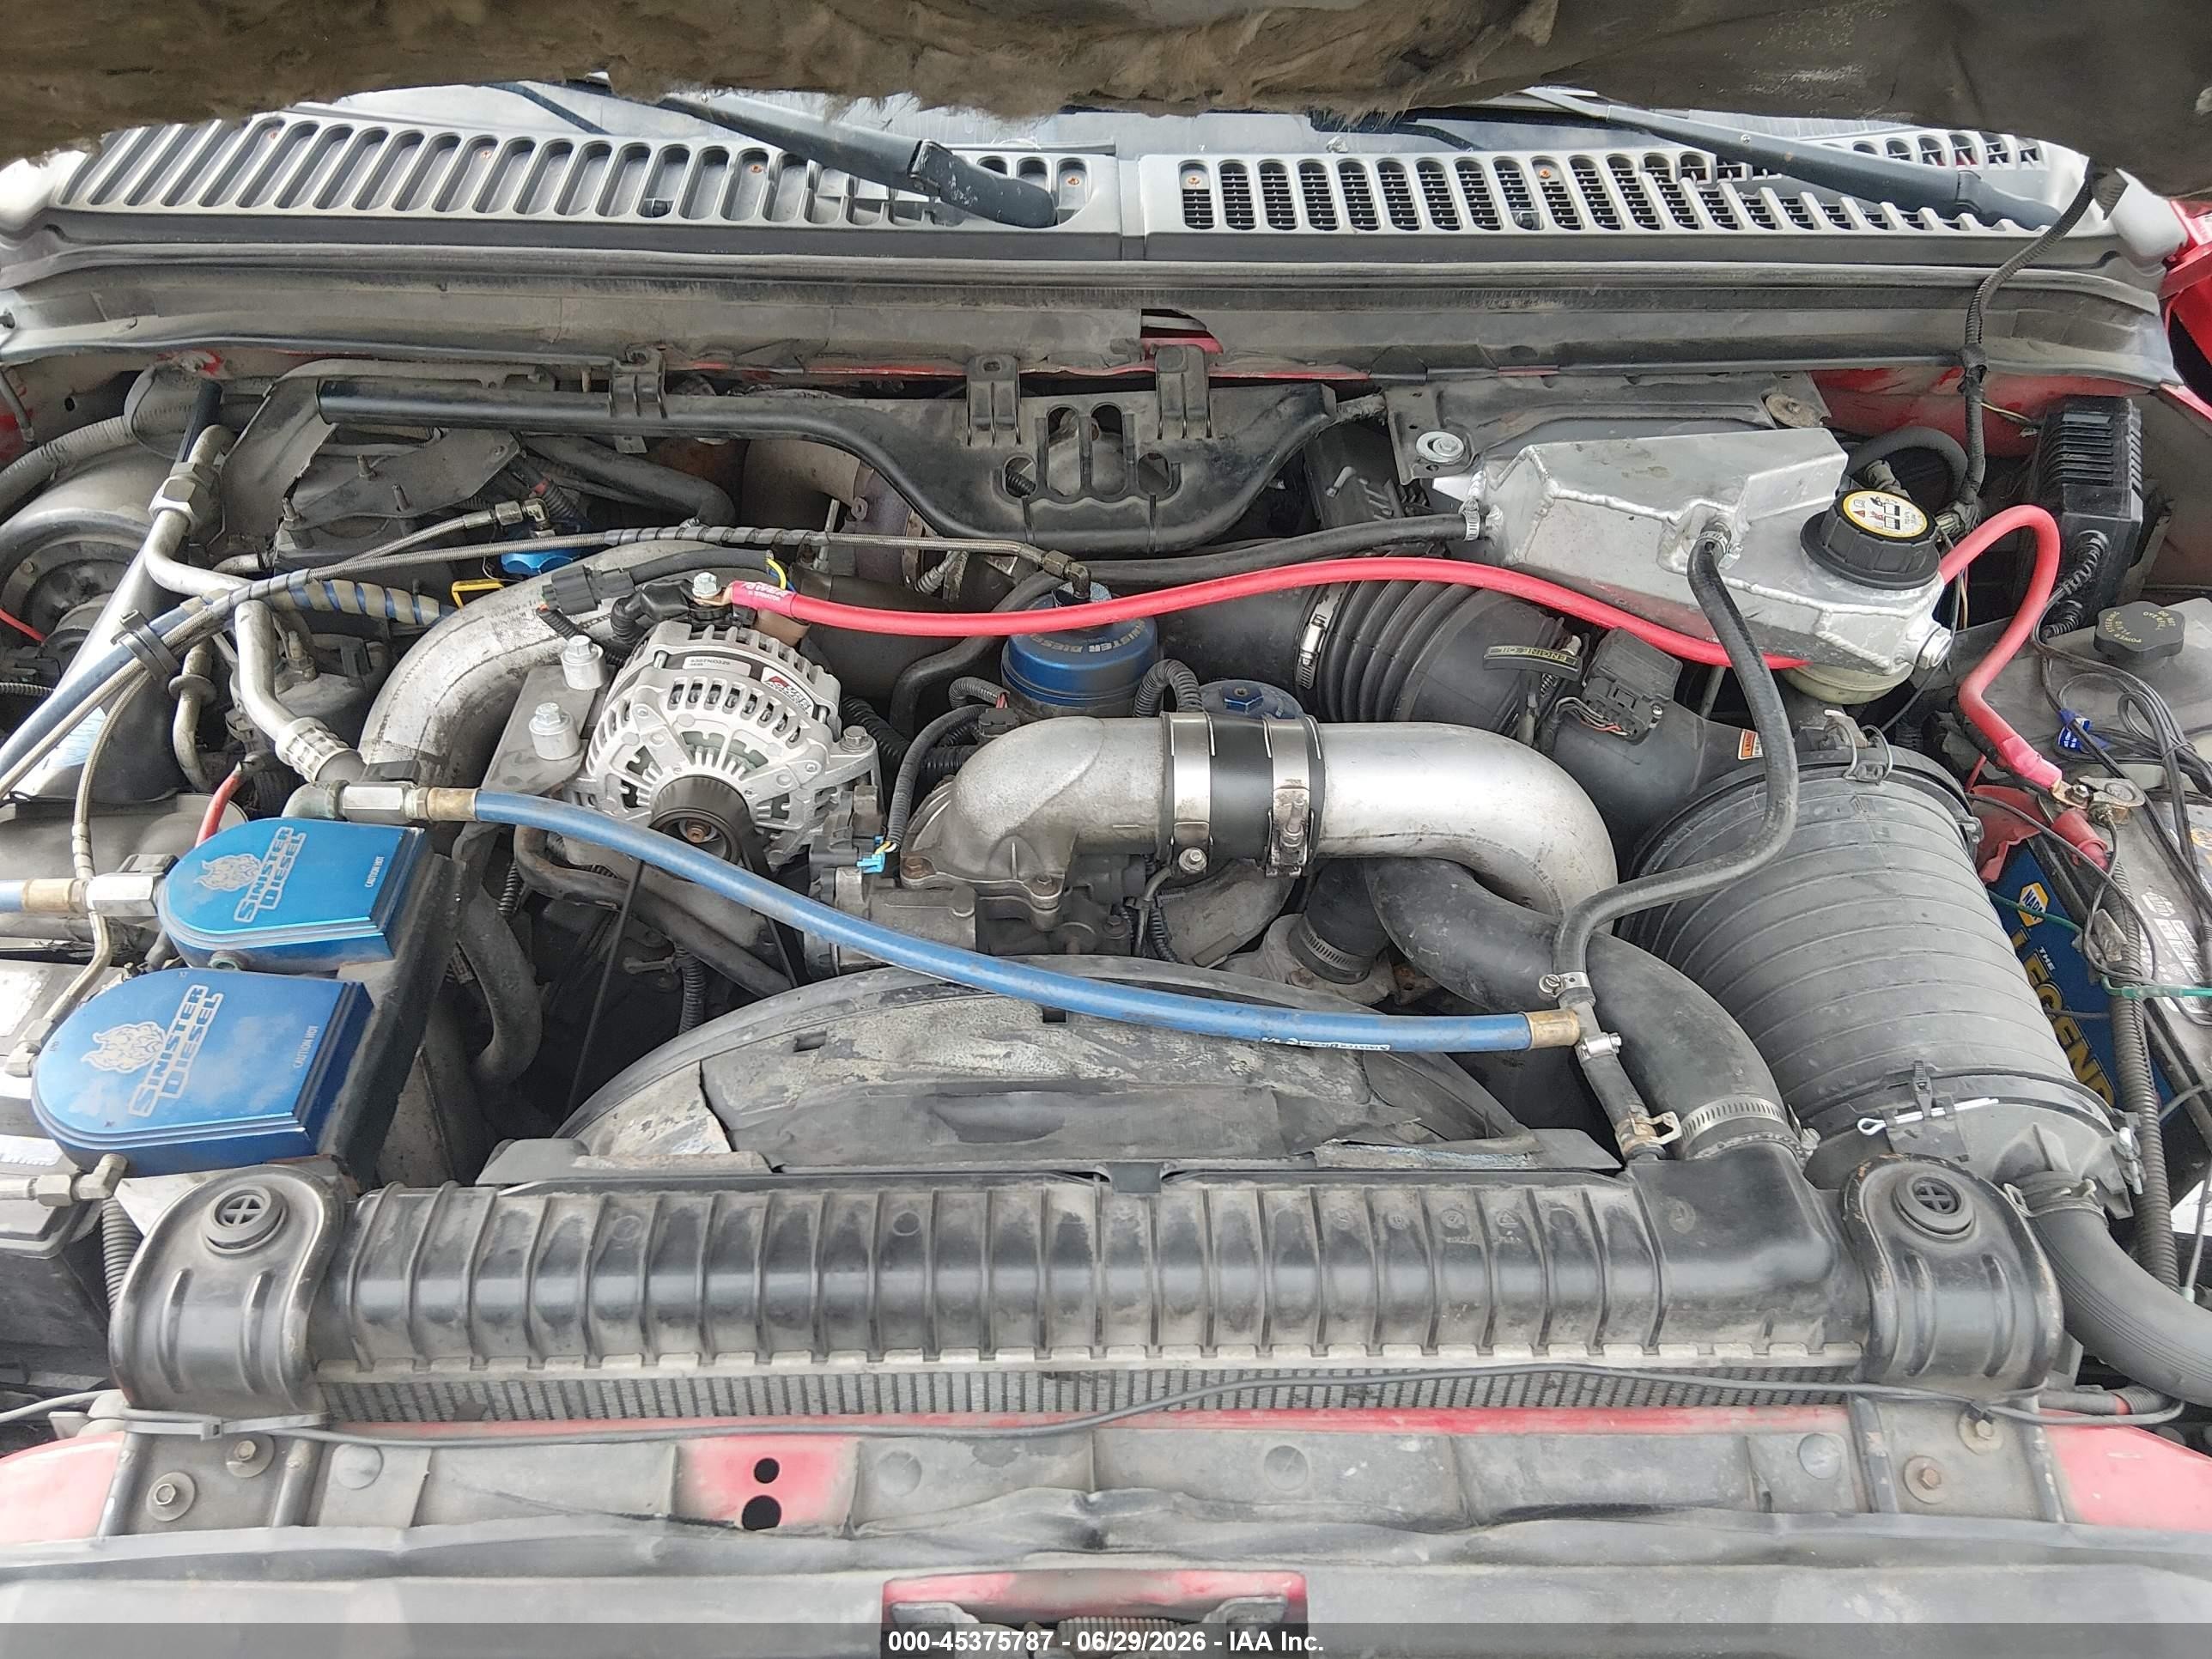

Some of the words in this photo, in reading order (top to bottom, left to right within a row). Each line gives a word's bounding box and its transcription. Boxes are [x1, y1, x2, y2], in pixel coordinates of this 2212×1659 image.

[1522, 648, 1567, 661] ENGINE
[2113, 634, 2142, 643] POWER
[234, 827, 293, 921] SINISTER
[260, 834, 305, 908] DIESEL
[2039, 946, 2056, 972] THE
[130, 986, 207, 1116] SINISTER
[159, 994, 223, 1097] DIESEL
[293, 1039, 314, 1068] CAUTION
[304, 1025, 319, 1038] HOT
